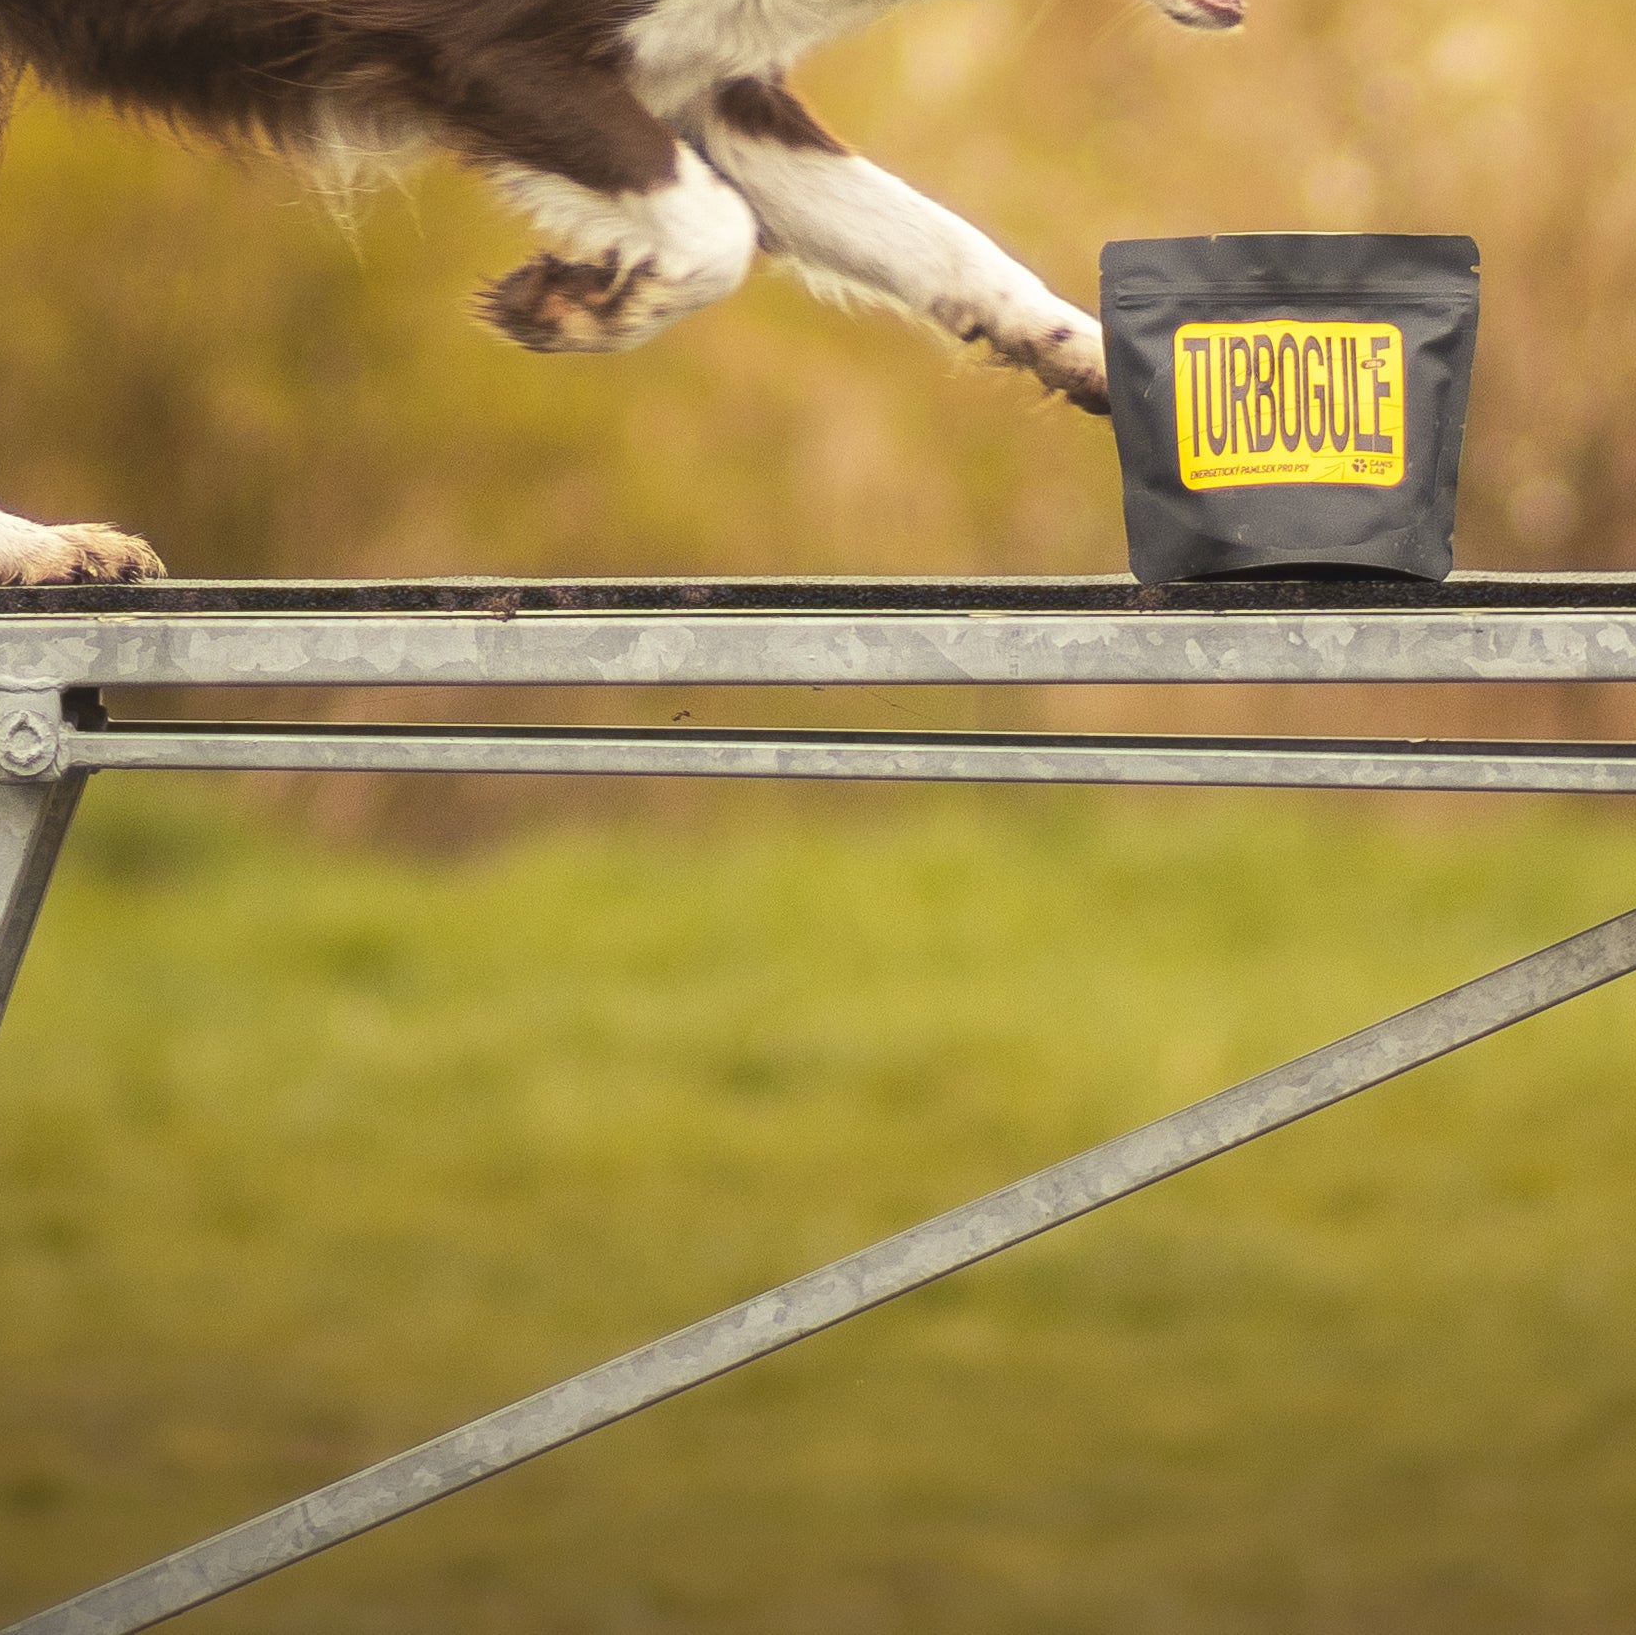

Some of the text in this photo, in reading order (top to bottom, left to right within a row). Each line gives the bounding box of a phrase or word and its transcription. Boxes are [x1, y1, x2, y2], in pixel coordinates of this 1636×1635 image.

[1183, 332, 1393, 457] TURBOGULE
[1277, 463, 1293, 473] PRO
[1294, 463, 1310, 473] PSY
